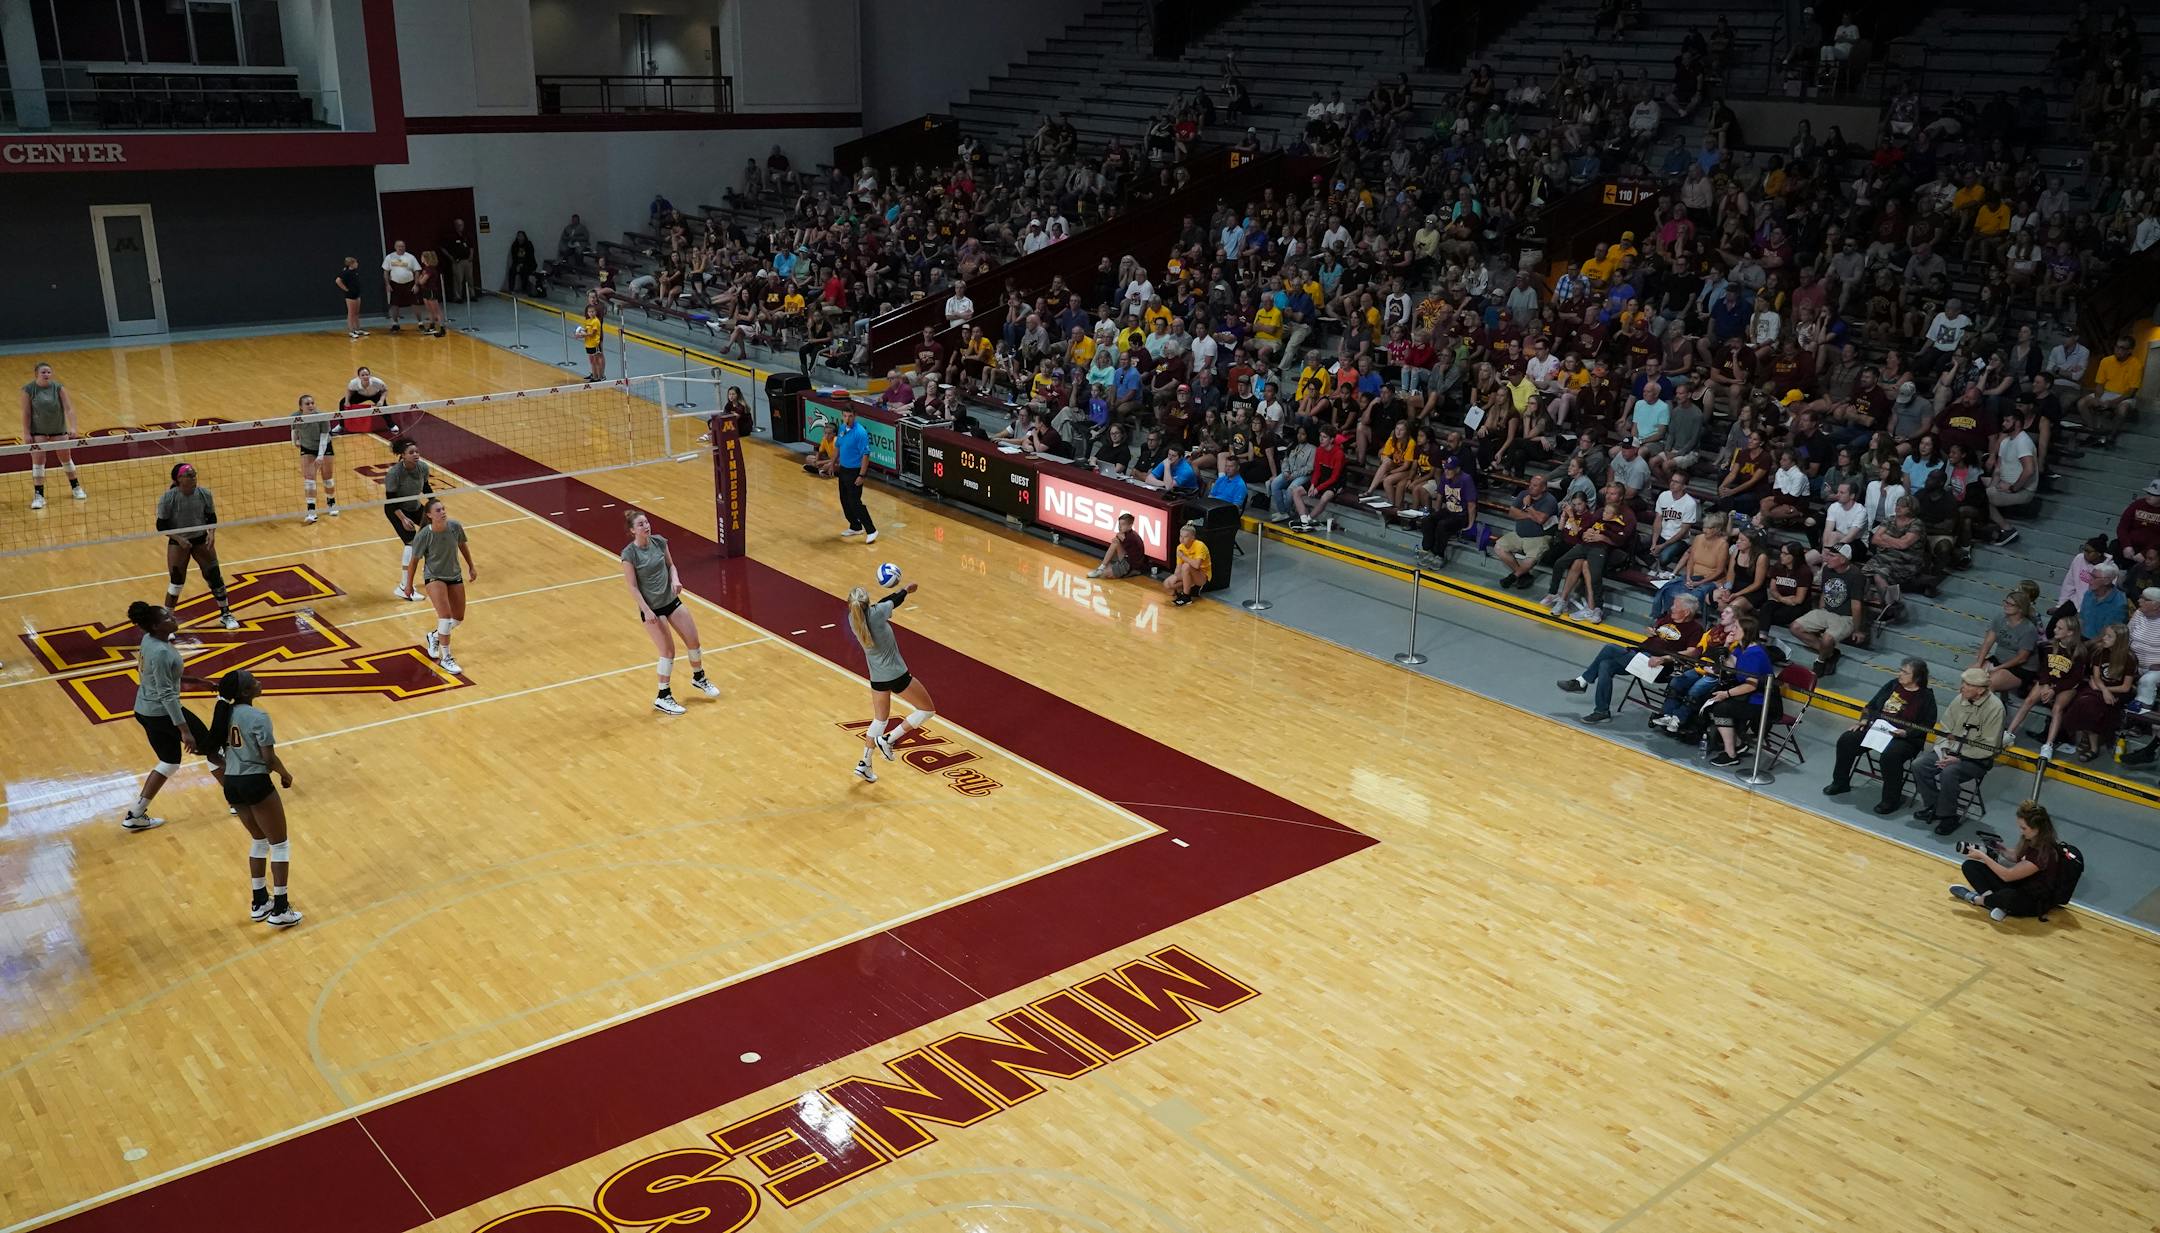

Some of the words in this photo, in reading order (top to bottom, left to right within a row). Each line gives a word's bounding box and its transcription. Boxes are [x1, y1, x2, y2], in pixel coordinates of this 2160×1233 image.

[3, 143, 127, 163] CENTER
[1619, 190, 1632, 201] 110
[927, 447, 944, 460] HOME
[961, 451, 987, 472] 00.0
[933, 462, 944, 478] 18
[726, 439, 740, 530] MINNESOTA
[963, 479, 979, 490] PERIOD
[1010, 473, 1030, 487] GUEST
[1018, 490, 1030, 504] 19
[942, 767, 1003, 797] The
[468, 943, 1262, 1233] MINNES
